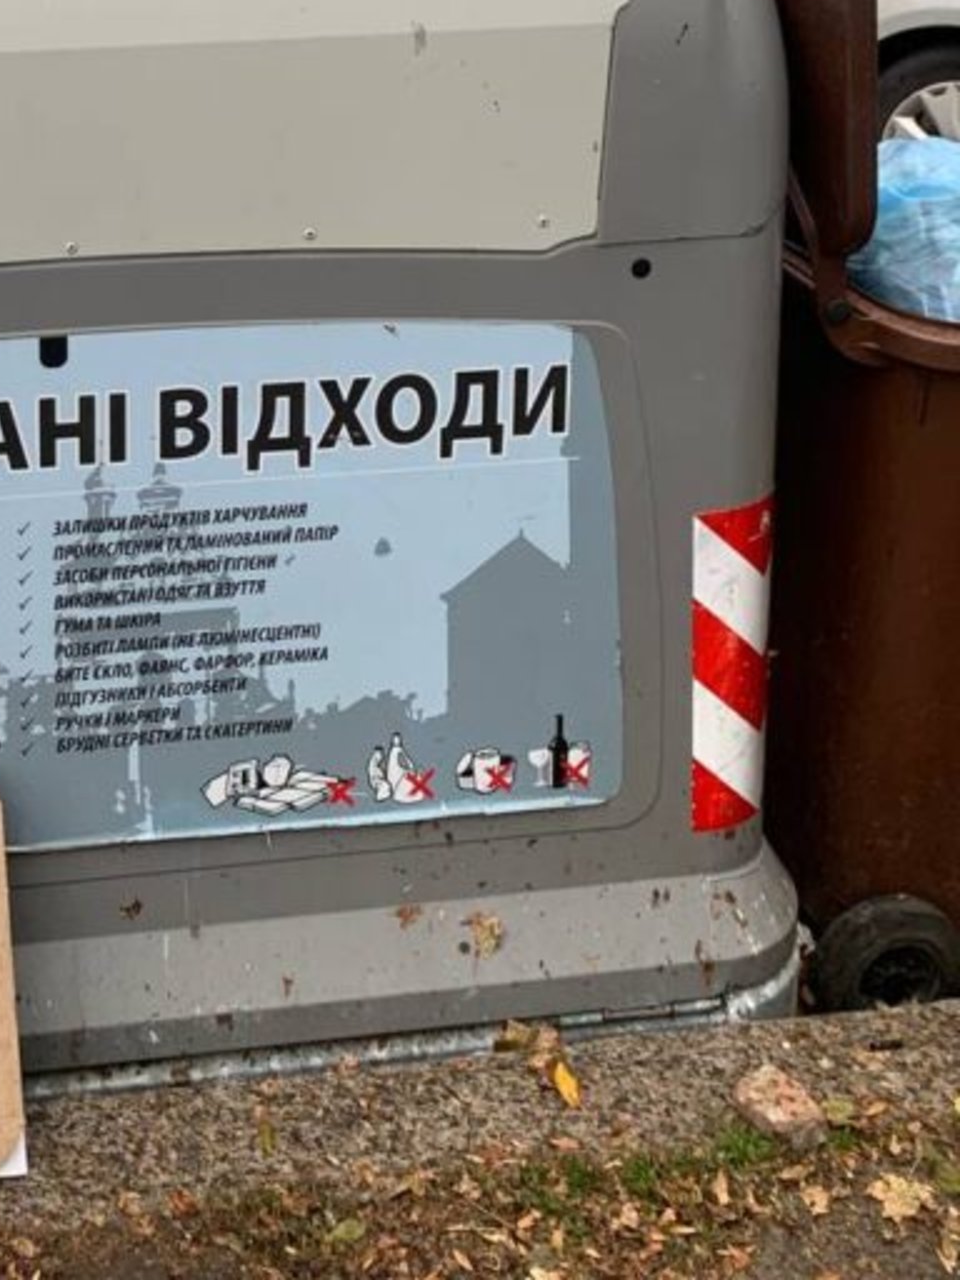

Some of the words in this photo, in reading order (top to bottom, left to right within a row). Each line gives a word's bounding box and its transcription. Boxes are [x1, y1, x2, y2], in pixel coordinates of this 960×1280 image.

[158, 365, 569, 468] ВІДХОДИ
[53, 518, 127, 535] ЗАЛИШКИ
[129, 510, 211, 529] ПРОДУКТІВ
[212, 503, 308, 523] ХАРЧУВАННЯ
[53, 538, 164, 559] ПРОМАСЛЕНИЙ
[166, 536, 184, 552] ТА
[185, 526, 292, 549] ЛАМІНОВАНИЙ
[294, 526, 339, 541] ПАПІР
[53, 568, 109, 585] ЗАСОБИ
[111, 557, 223, 580] ПЕРСОНАЛЬНОЇ
[54, 588, 153, 609] ВИКОРИСТАНІ
[155, 584, 193, 604] ОДЯГ
[195, 582, 212, 598] ТА
[214, 580, 266, 597] ВЗУТТЯ
[54, 617, 92, 635] ГУМА
[96, 615, 112, 631] ТА
[114, 613, 161, 628] ШКІРА
[54, 640, 114, 659] РОЗБИТІ
[115, 635, 170, 651] ЛАМПИ
[171, 632, 194, 650] (НЕ
[196, 623, 322, 646] ЛЮМІНЕСЦЕНТНІ)
[54, 666, 90, 683] БИТЕ
[93, 662, 134, 679] СКЛО,
[193, 652, 256, 671] ФАРФОР,
[258, 647, 329, 665] КЕРАМІКА
[54, 686, 147, 707] ПІДГУЗНИКИ
[157, 677, 248, 697] АБСОРБЕНТИ
[55, 714, 103, 730] РУЧКИ
[113, 707, 182, 725] МАРКЕРИ
[56, 735, 112, 753] БРУДНІ
[113, 727, 184, 747] СЕРВЕТКИ
[187, 724, 203, 741] ТА
[204, 719, 294, 739] СКАТЕРТИНИ
